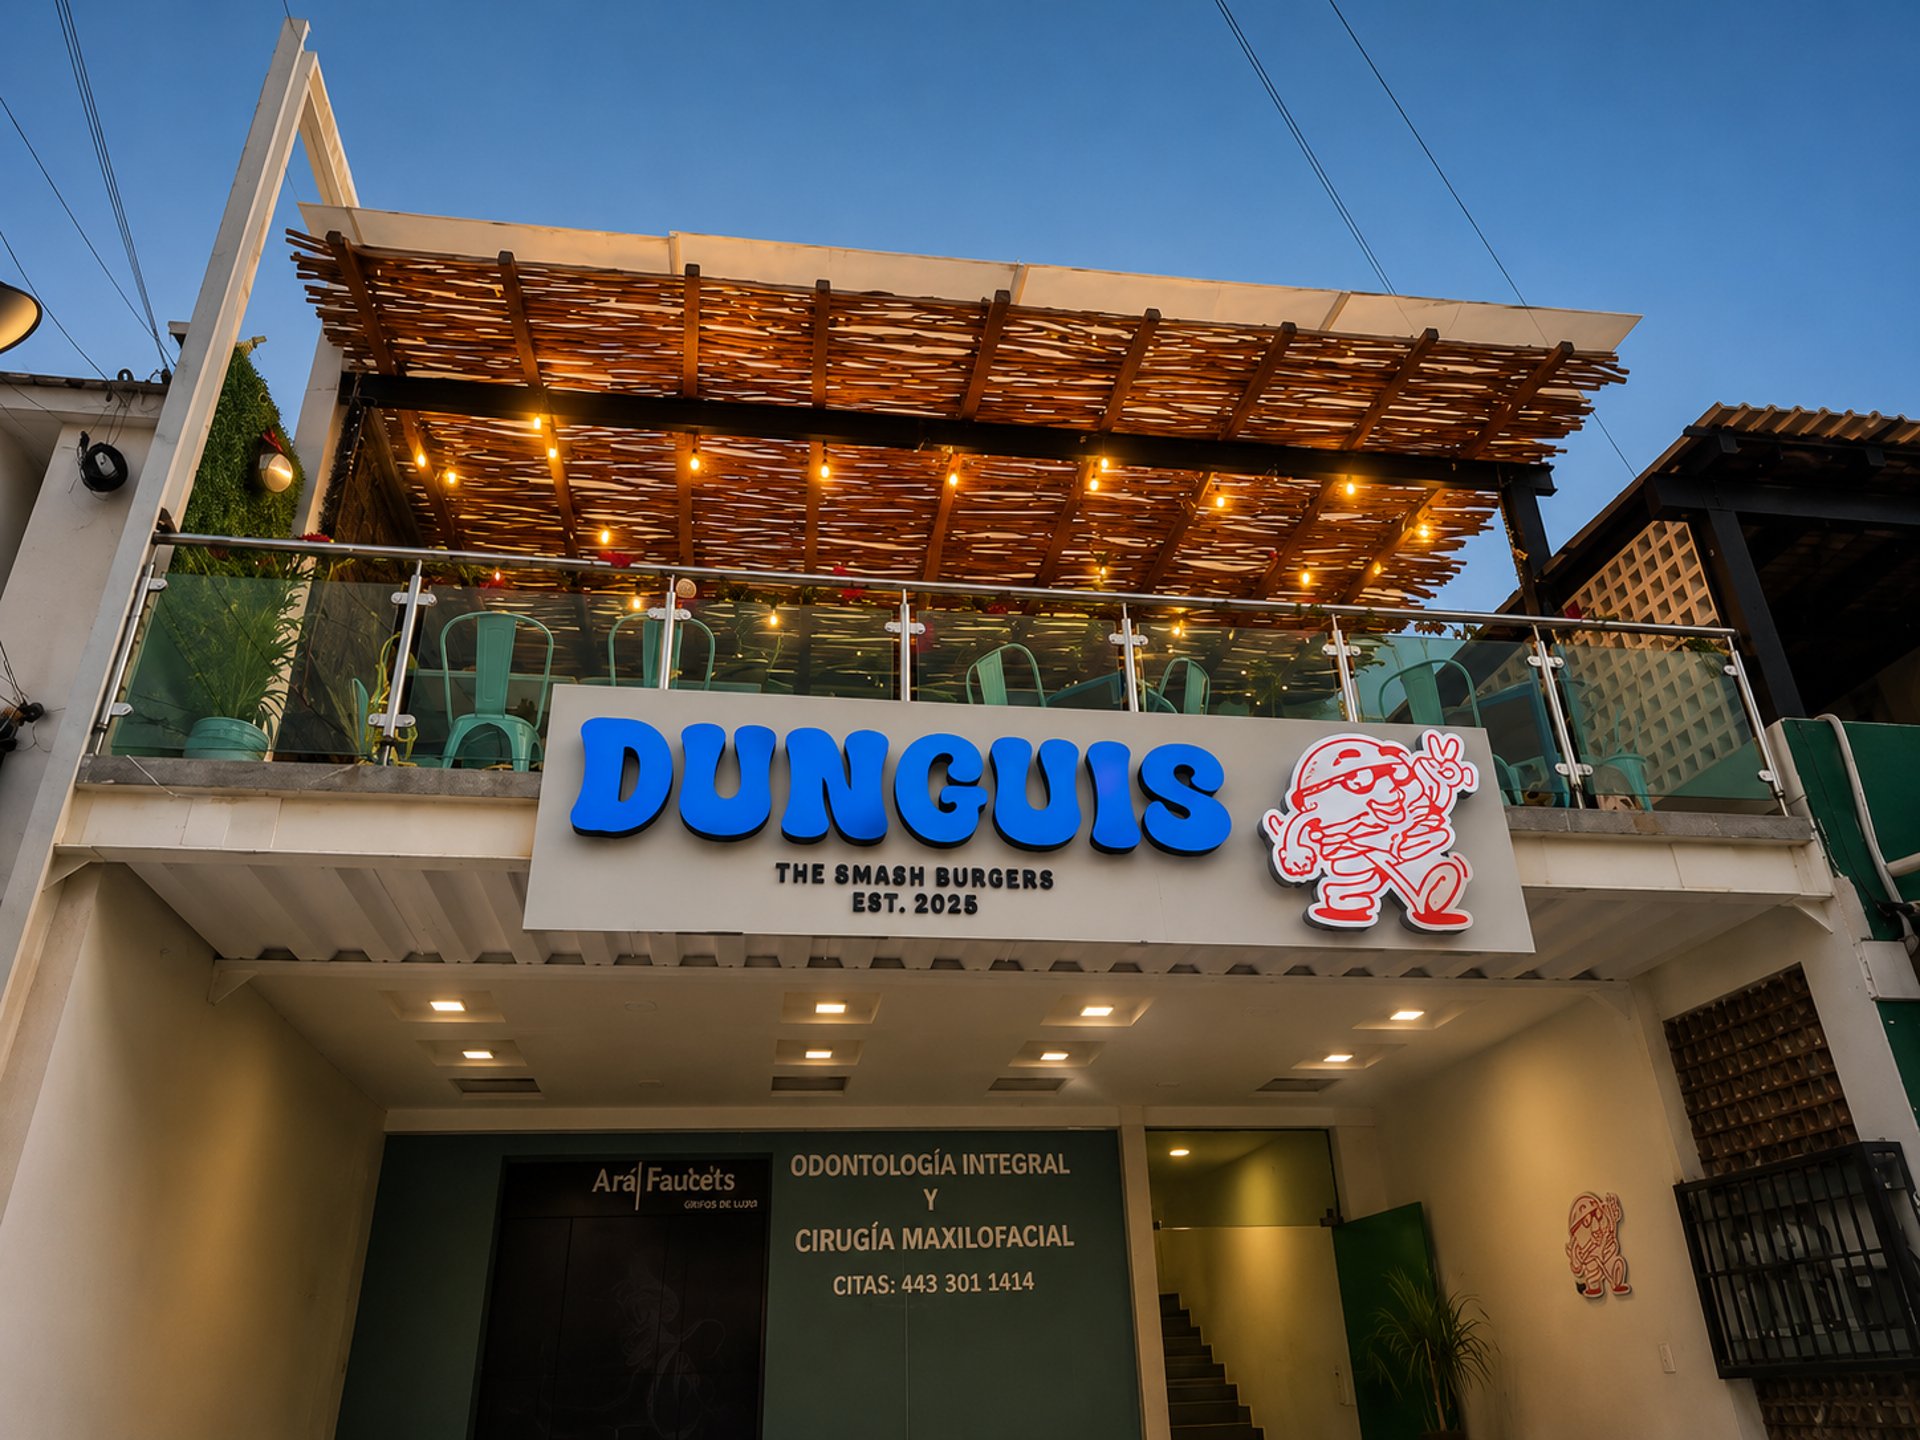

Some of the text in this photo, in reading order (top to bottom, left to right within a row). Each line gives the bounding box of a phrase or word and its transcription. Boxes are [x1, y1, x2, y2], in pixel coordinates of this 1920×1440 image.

[571, 717, 1231, 857] DUNGUIS
[775, 862, 1055, 891] THE SMASH BURGERS
[852, 891, 979, 917] EST. 2025
[790, 1148, 1071, 1177] ODONTOLOGÍA INTEGRAL
[719, 1199, 732, 1209] DE
[923, 1188, 938, 1210] Y
[794, 1221, 1076, 1252] CIRUGÍA MAXILOFACIAL
[833, 1271, 1035, 1295] CITAS: 443 301 1414
